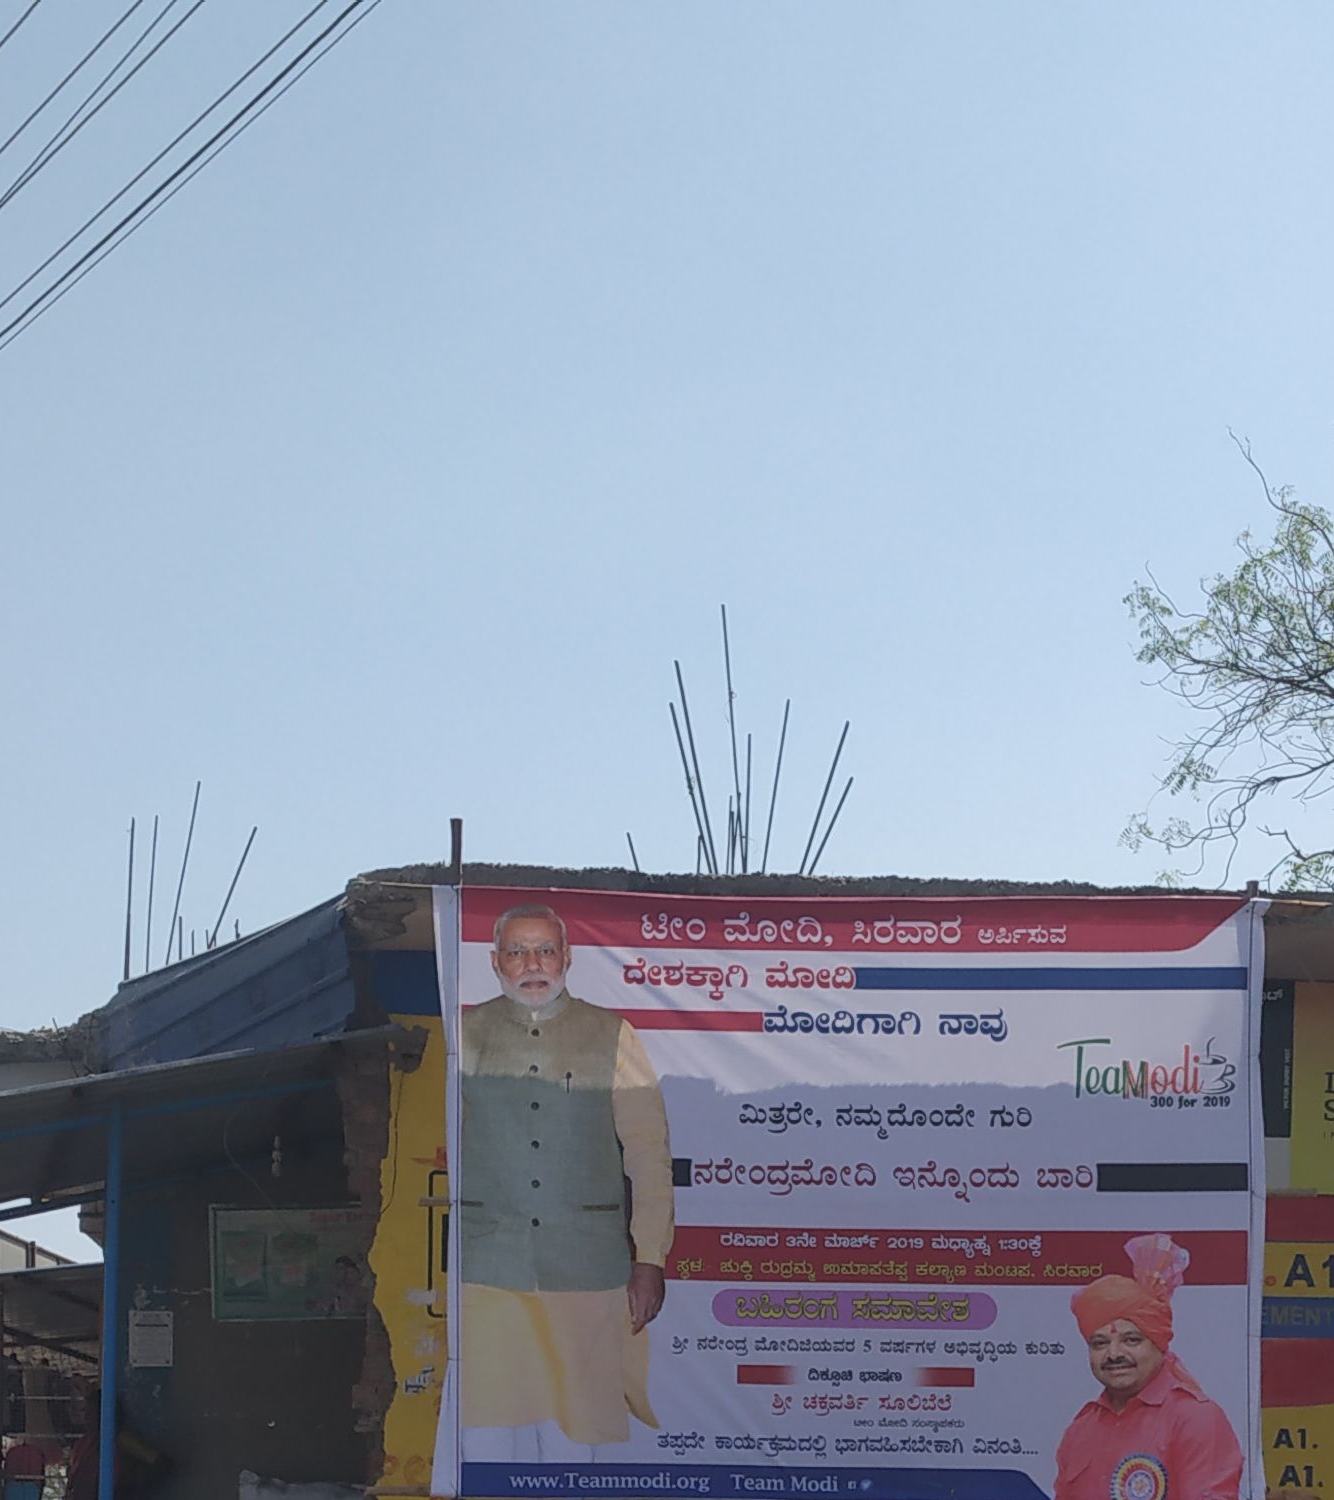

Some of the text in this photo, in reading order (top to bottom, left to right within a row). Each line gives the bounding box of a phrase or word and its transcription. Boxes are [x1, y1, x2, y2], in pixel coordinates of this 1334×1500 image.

[641, 913, 706, 941] ಟೀಂ
[723, 912, 834, 947] ಮೋದಿ,
[852, 914, 963, 944] ಸಿರವಾರ
[622, 957, 856, 1000] ದೇಶಕ್ಕಾಗಿ ಮೋದಿ
[763, 1005, 1008, 1042] ಮೋದಿಗಾಗಿ ನಾವು
[1150, 1095, 1231, 1109] 300 for 2019
[739, 1101, 1033, 1140] ಮಿತ್ರರೇ, ನಮ್ಮದೊಂದೇ ಗುರಿ
[694, 1157, 1094, 1203] ನರೇಂದ್ರಮೋದಿ ಇನ್ನೊಂದು ಬಾರಿ
[720, 1231, 779, 1247] ರವಿವಾರ
[824, 1232, 880, 1249] ಮಾರ್ಚ್
[887, 1237, 924, 1249] 2019
[915, 1261, 967, 1284] ಕಲ್ಯಾಣ
[1042, 1262, 1104, 1278] ಸಿರವಾರ
[735, 1291, 971, 1322] ಬಹಿರಂಗ ಸಮಾವೇಶ
[671, 1335, 689, 1355] ಶ್ರೀ
[697, 1336, 749, 1357] ನರೇಂದ್ರ
[863, 1339, 872, 1353] 5
[879, 1339, 937, 1355] ವರ್ಷಗಳ
[1025, 1341, 1066, 1356] ಕುರಿತು
[858, 1368, 903, 1384] ಭಾಷಣ
[771, 1392, 952, 1417] ಶ್ರೀ ಚಕ್ರವರ್ತಿ ಸೂಲಿಬೆಲೆ
[657, 1431, 706, 1456] ತಪ್ಪದೇ
[714, 1432, 828, 1458] ಕಾರ್ಯಕ್ರಮದಲ್ಲಿ
[834, 1435, 964, 1455] ಭಾಗವಹಿಸಬೇಕಾಗಿ
[508, 1471, 839, 1493] www.Teammodi.org Team Modi
